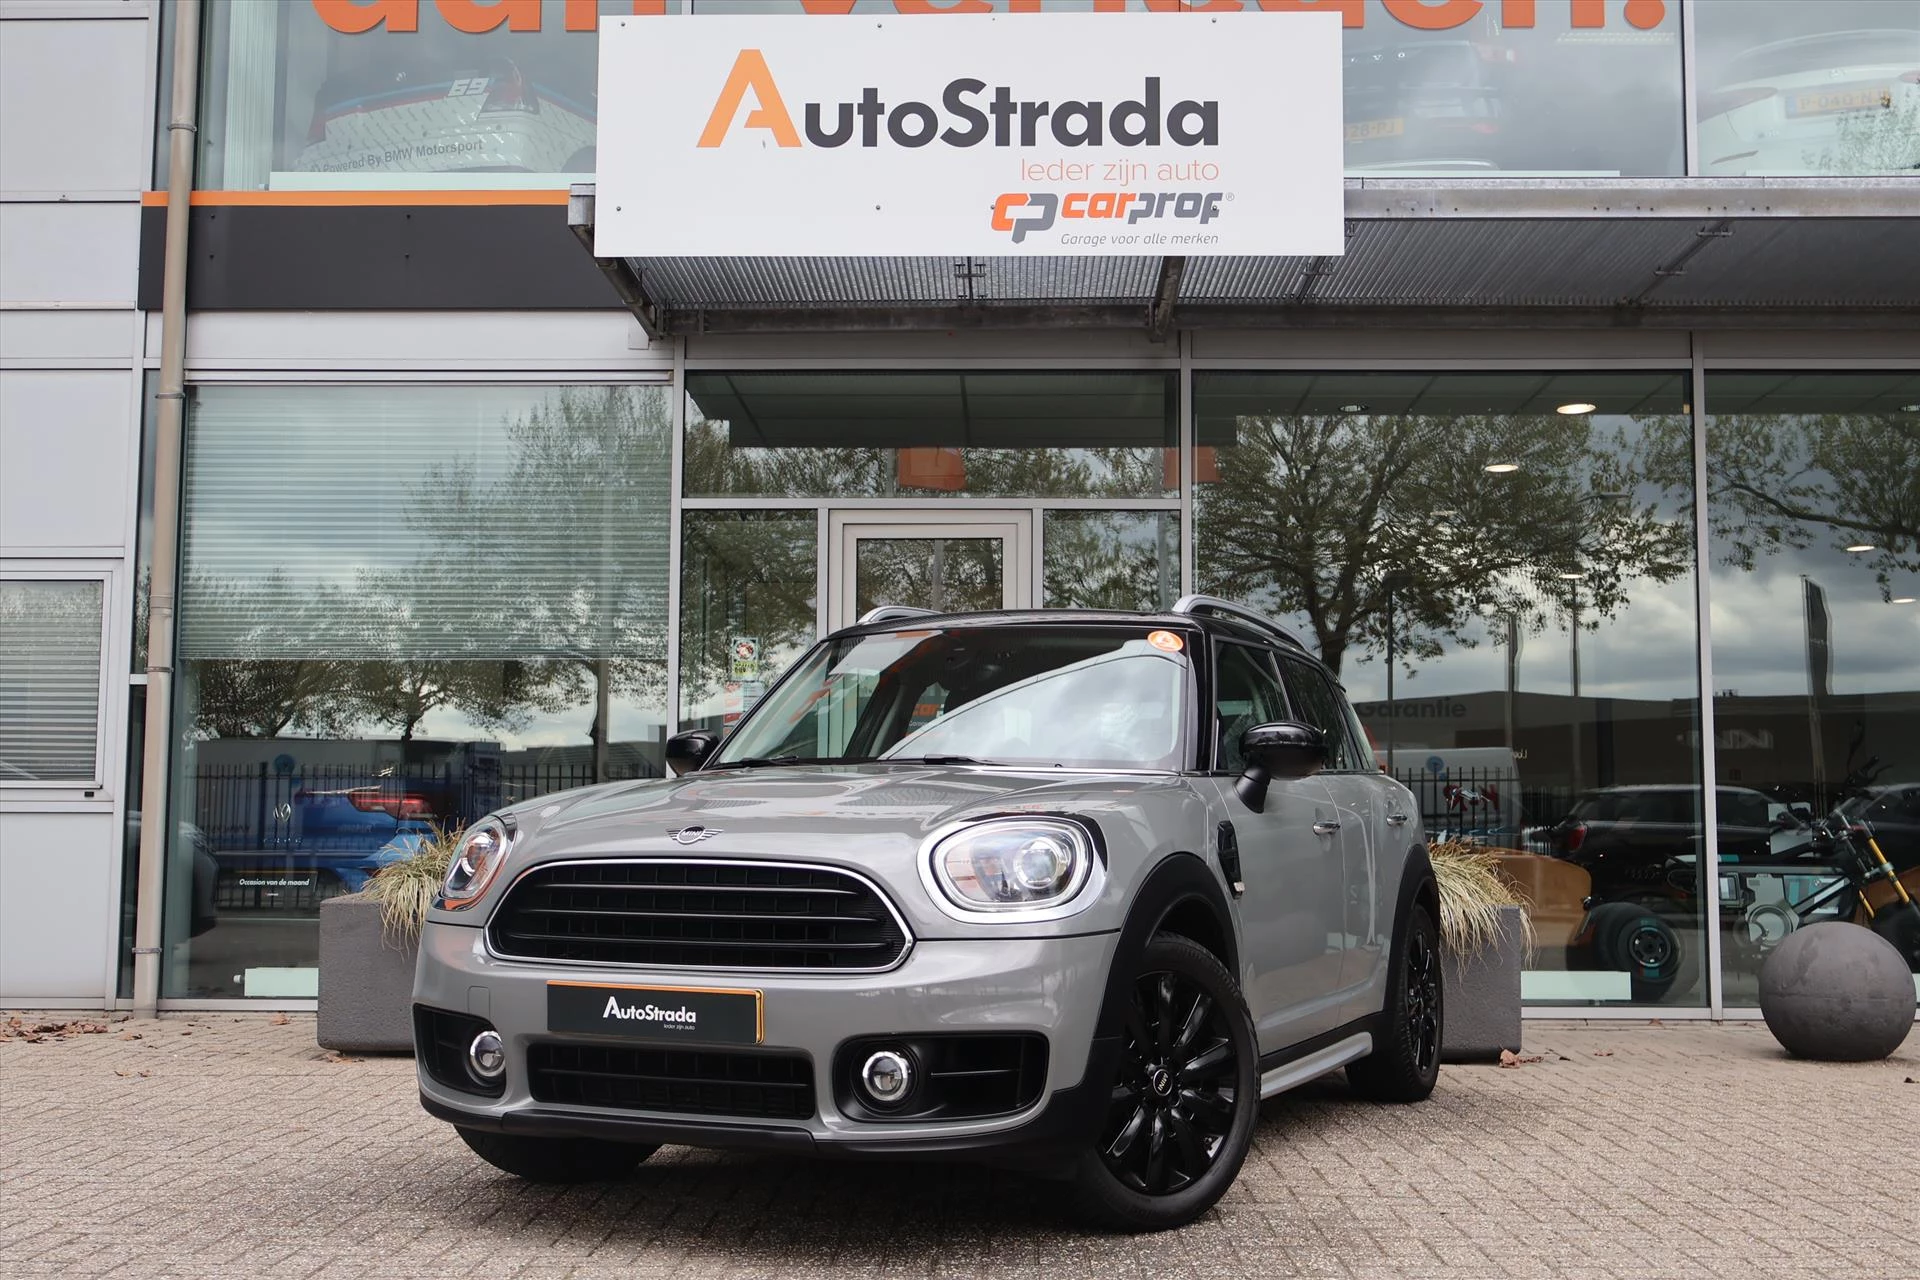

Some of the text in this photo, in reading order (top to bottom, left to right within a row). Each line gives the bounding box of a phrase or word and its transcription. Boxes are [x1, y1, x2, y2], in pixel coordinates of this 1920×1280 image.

[448, 78, 489, 96] 69
[696, 49, 1219, 149] AutoStrada
[323, 156, 365, 172] Powered
[368, 155, 381, 166] By
[385, 148, 413, 162] BMW
[416, 140, 483, 157] Motorsport
[1022, 159, 1219, 187] Ieder zijn auto
[1061, 233, 1219, 247] Garage voor alle merken
[1356, 697, 1467, 718] Garantie
[603, 996, 696, 1023] AutoStrada
